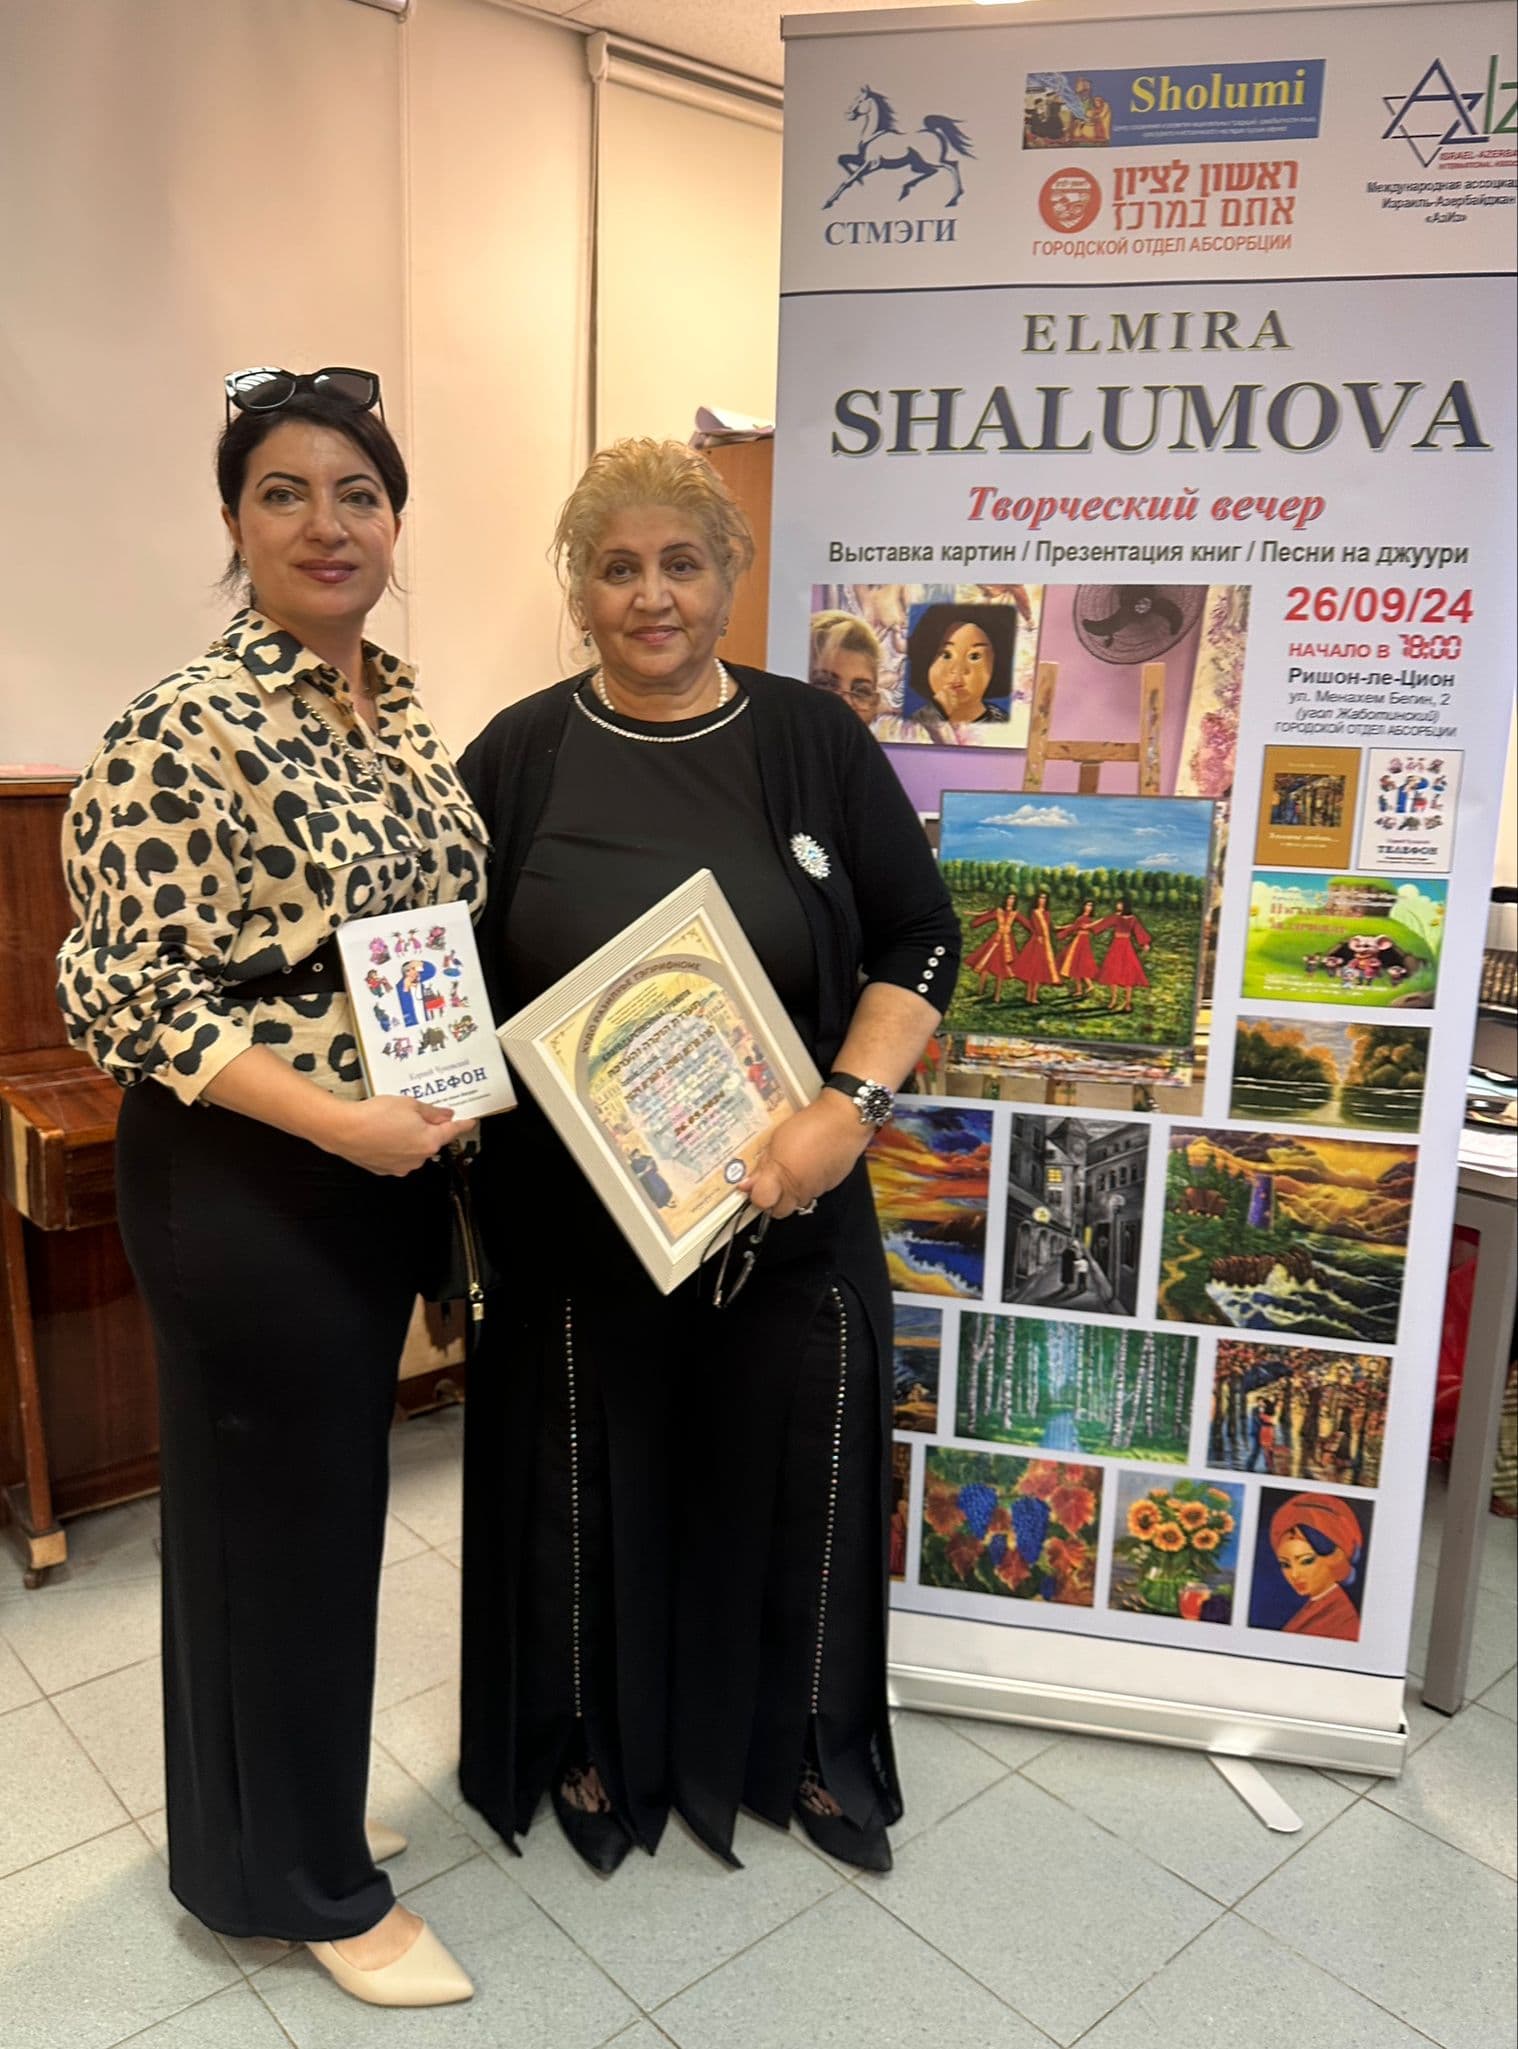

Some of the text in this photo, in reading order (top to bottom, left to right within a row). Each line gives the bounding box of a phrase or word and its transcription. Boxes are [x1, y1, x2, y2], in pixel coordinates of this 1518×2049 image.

[1130, 68, 1306, 113] Sholumi
[1113, 159, 1299, 201] ראשון לציון
[1366, 180, 1461, 194] Международная
[1112, 196, 1296, 231] אתם במרכז
[825, 218, 958, 245] СТМЭГИ
[1032, 234, 1293, 258] ГОРОДСКОЙ ОТДЕЛ АБСОРБЦИИ
[1021, 310, 1292, 353] ELMIRA
[832, 380, 1494, 456] SHALUMOVA
[967, 486, 1326, 531] Творческий вечер
[829, 540, 1469, 568] Выставка картин / Презентация книг / Песни на джуури
[1284, 586, 1475, 624] 26/09/24
[1288, 642, 1372, 658] НАЧАЛО
[1398, 633, 1463, 660] 18:00
[1288, 667, 1456, 689] Ришон-ле-Цион
[1288, 689, 1451, 707] ул. Менахем Бегин, 2
[1275, 721, 1458, 738] ГОРОДСКОЙ ОТДЕЛ АБСОРБЦИИ
[400, 1067, 487, 1099] ТЕЛЕФОН
